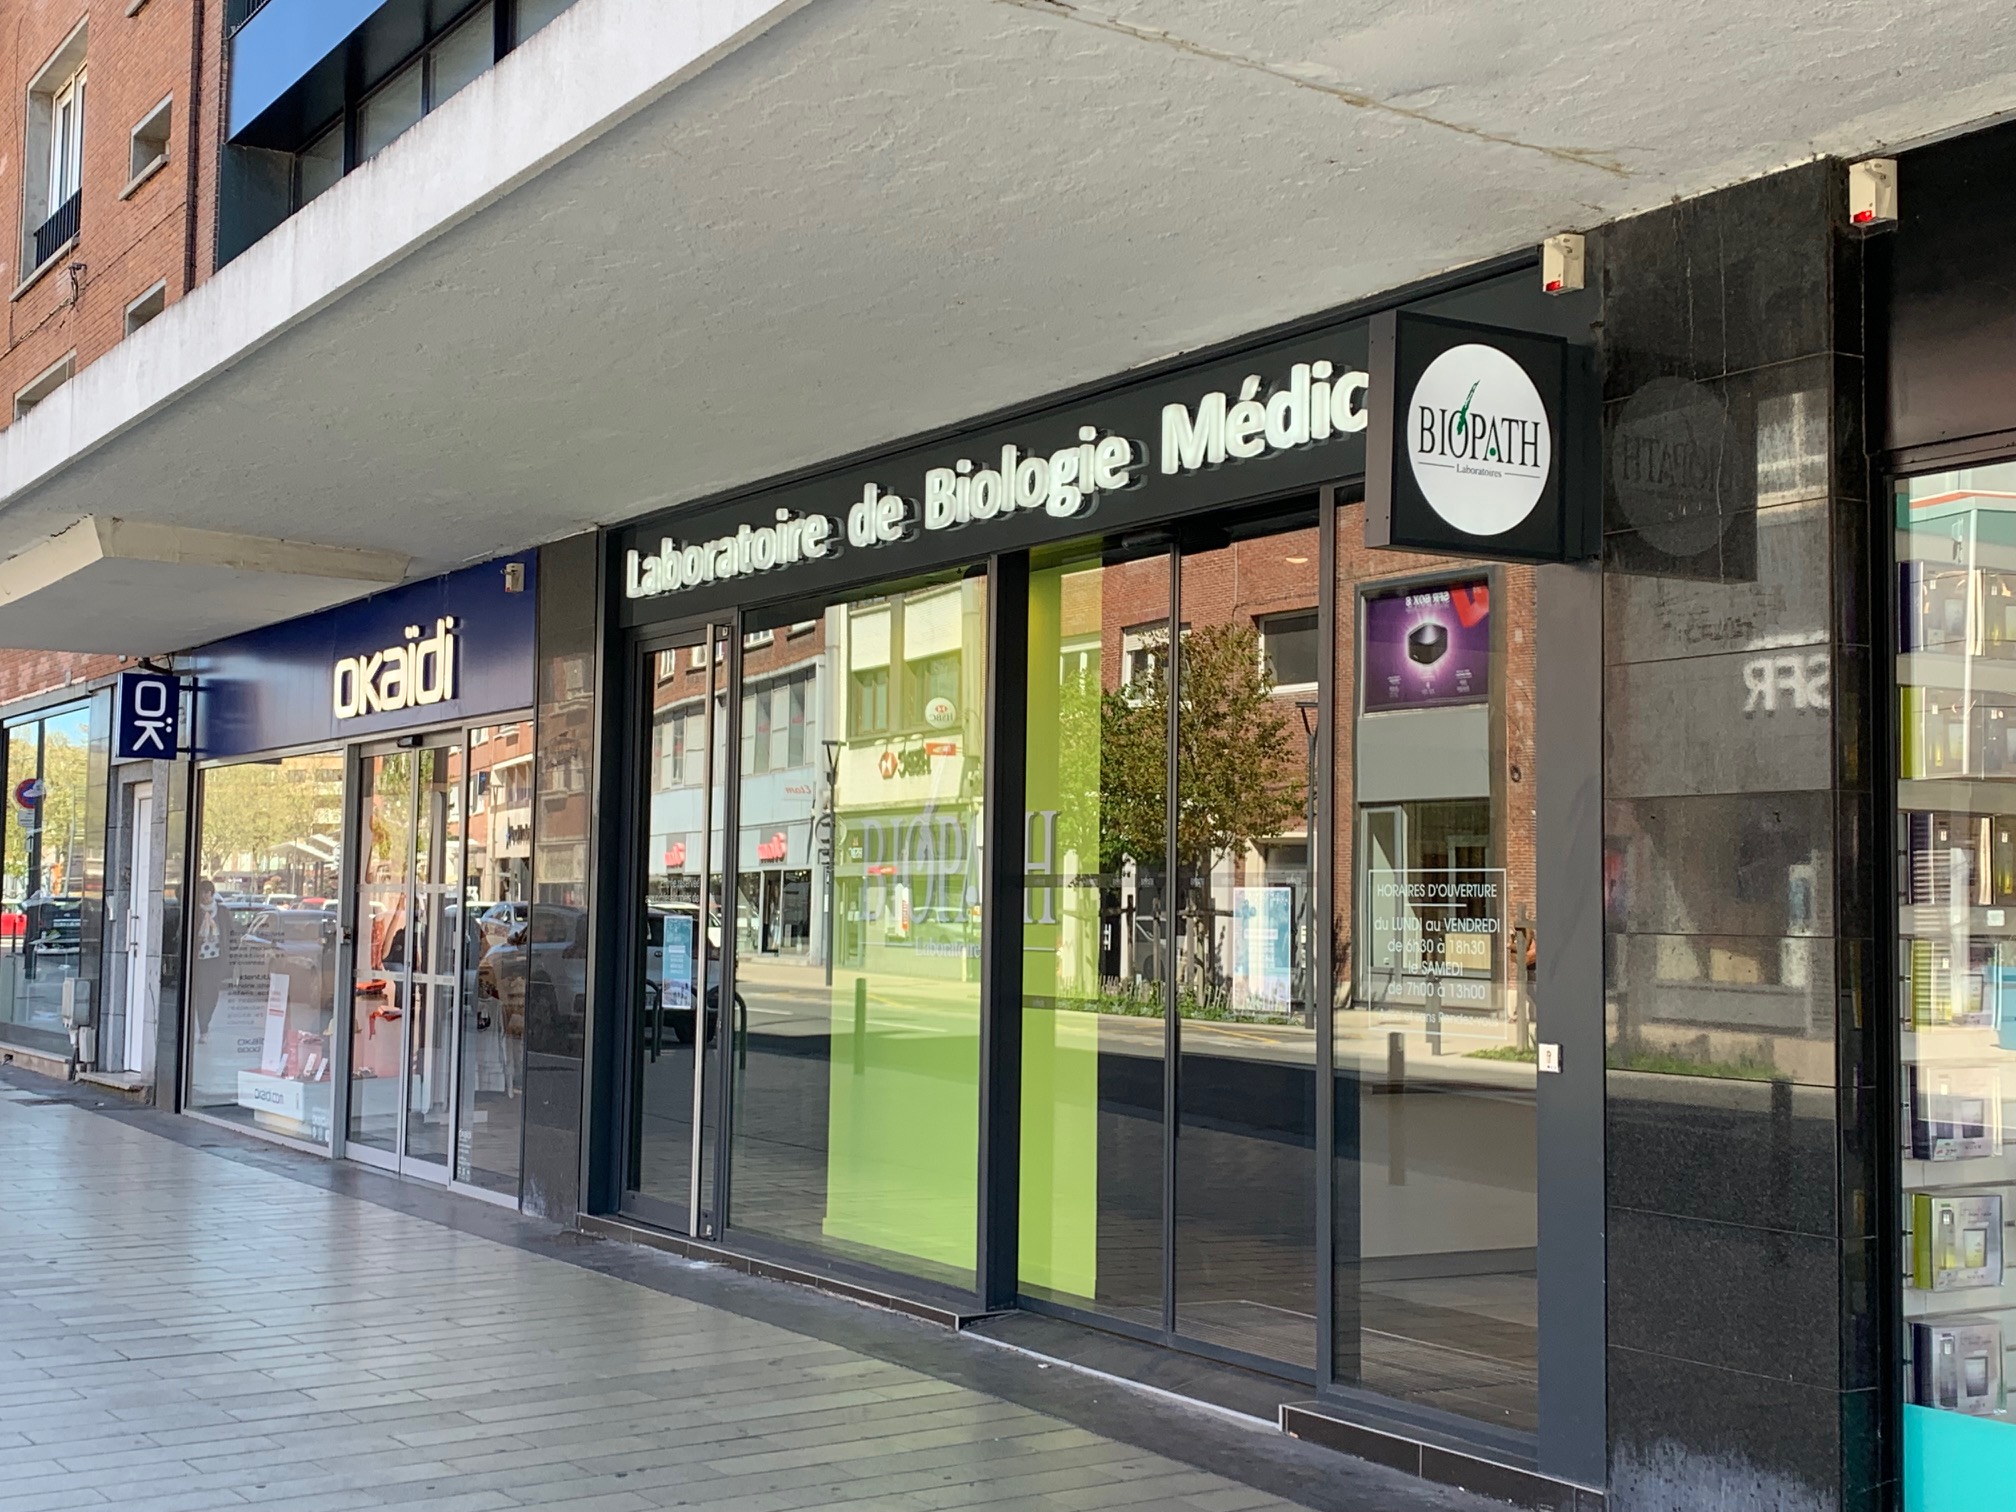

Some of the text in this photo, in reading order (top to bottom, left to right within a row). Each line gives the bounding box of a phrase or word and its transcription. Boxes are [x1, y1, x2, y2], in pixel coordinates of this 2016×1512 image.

[1418, 405, 1541, 468] BIOPATH
[1456, 463, 1502, 478] Laboratoires
[626, 360, 1369, 599] Laboratoire de Biologie Médic
[334, 615, 455, 720] okaïdi
[859, 810, 1061, 926] BIOPAH
[1377, 884, 1497, 897] HORAIRES D'OUVERTURE
[1375, 917, 1500, 933] du LUNDI au VENDREDI
[1388, 939, 1485, 955] de 6h30 à 18h30
[1408, 961, 1463, 976] le SAMEDI
[1388, 981, 1485, 1000] de 7h00 à 13h00
